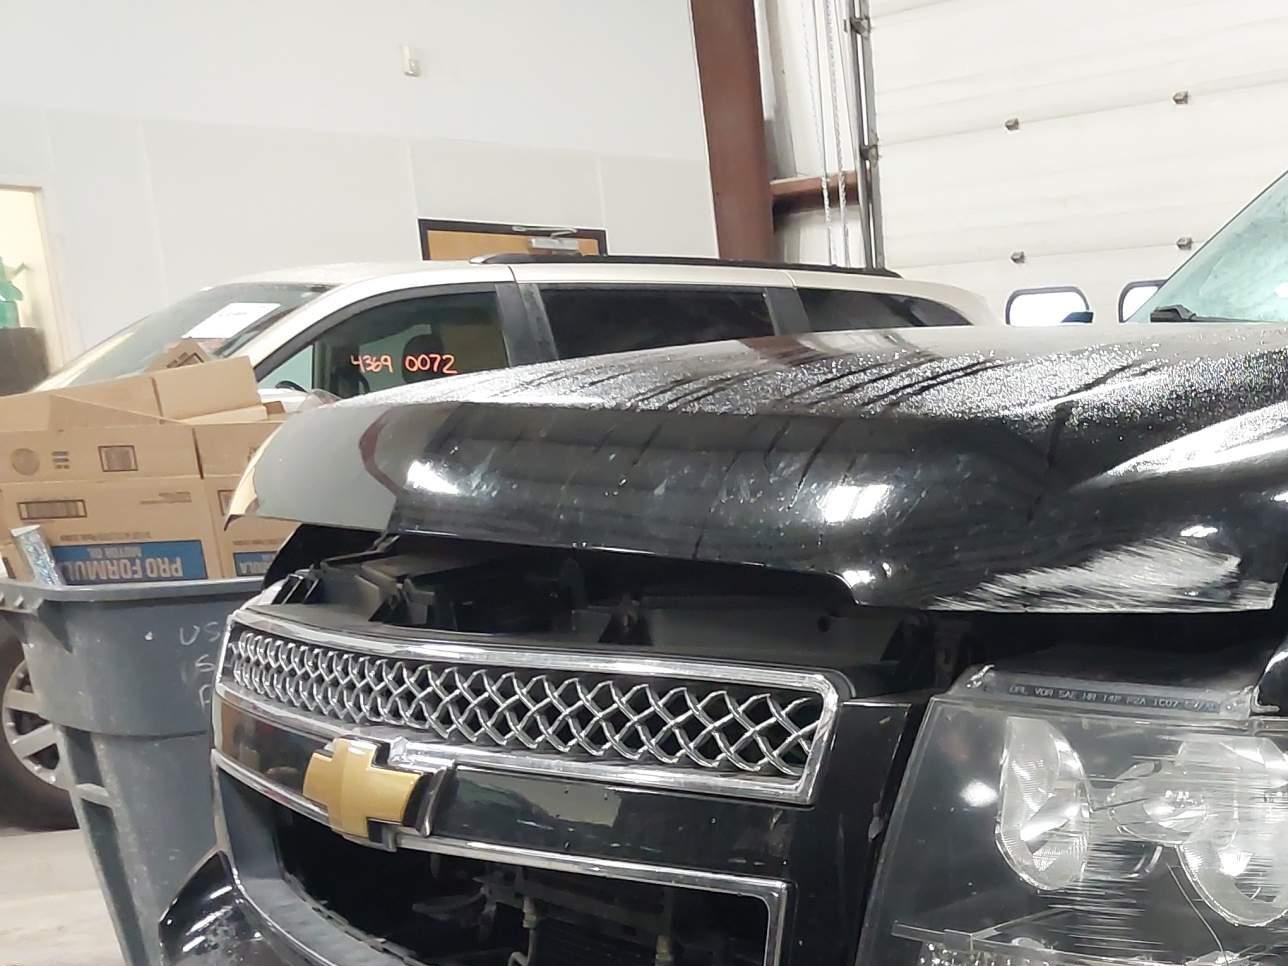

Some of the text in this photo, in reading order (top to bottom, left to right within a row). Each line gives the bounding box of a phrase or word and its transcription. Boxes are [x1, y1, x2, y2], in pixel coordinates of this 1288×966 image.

[350, 354, 458, 374] 4369 0072
[63, 556, 184, 581] PRO FORMUL
